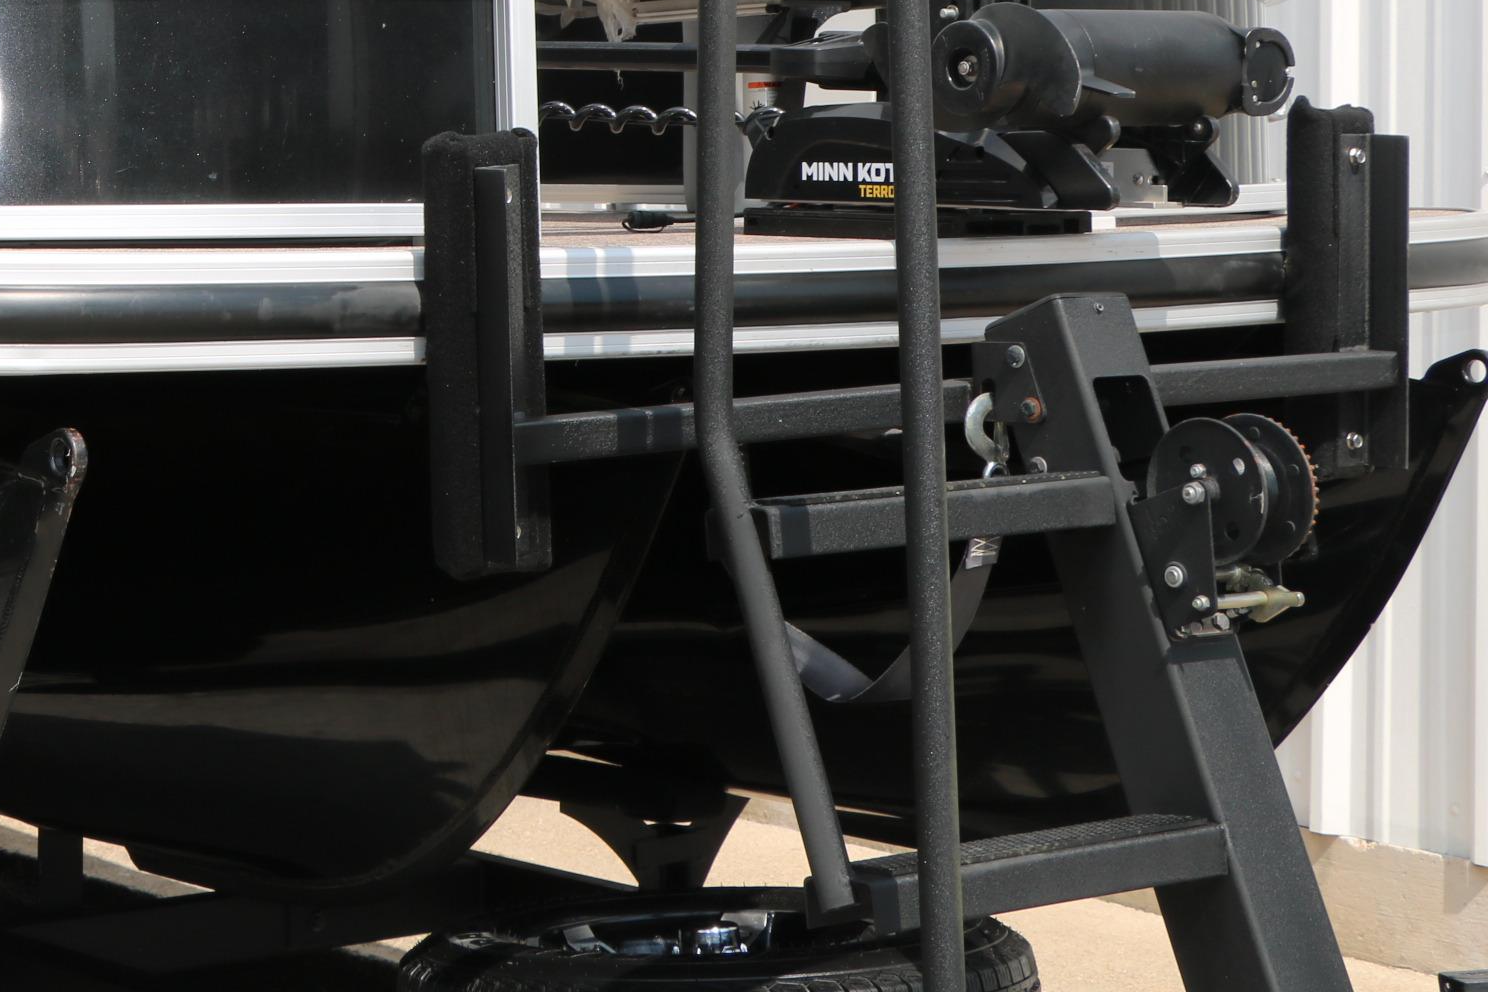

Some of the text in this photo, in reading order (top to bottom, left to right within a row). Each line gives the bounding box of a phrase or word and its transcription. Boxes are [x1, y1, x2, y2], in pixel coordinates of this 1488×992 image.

[801, 161, 895, 183] MINN KOT
[858, 184, 895, 198] TERRO
